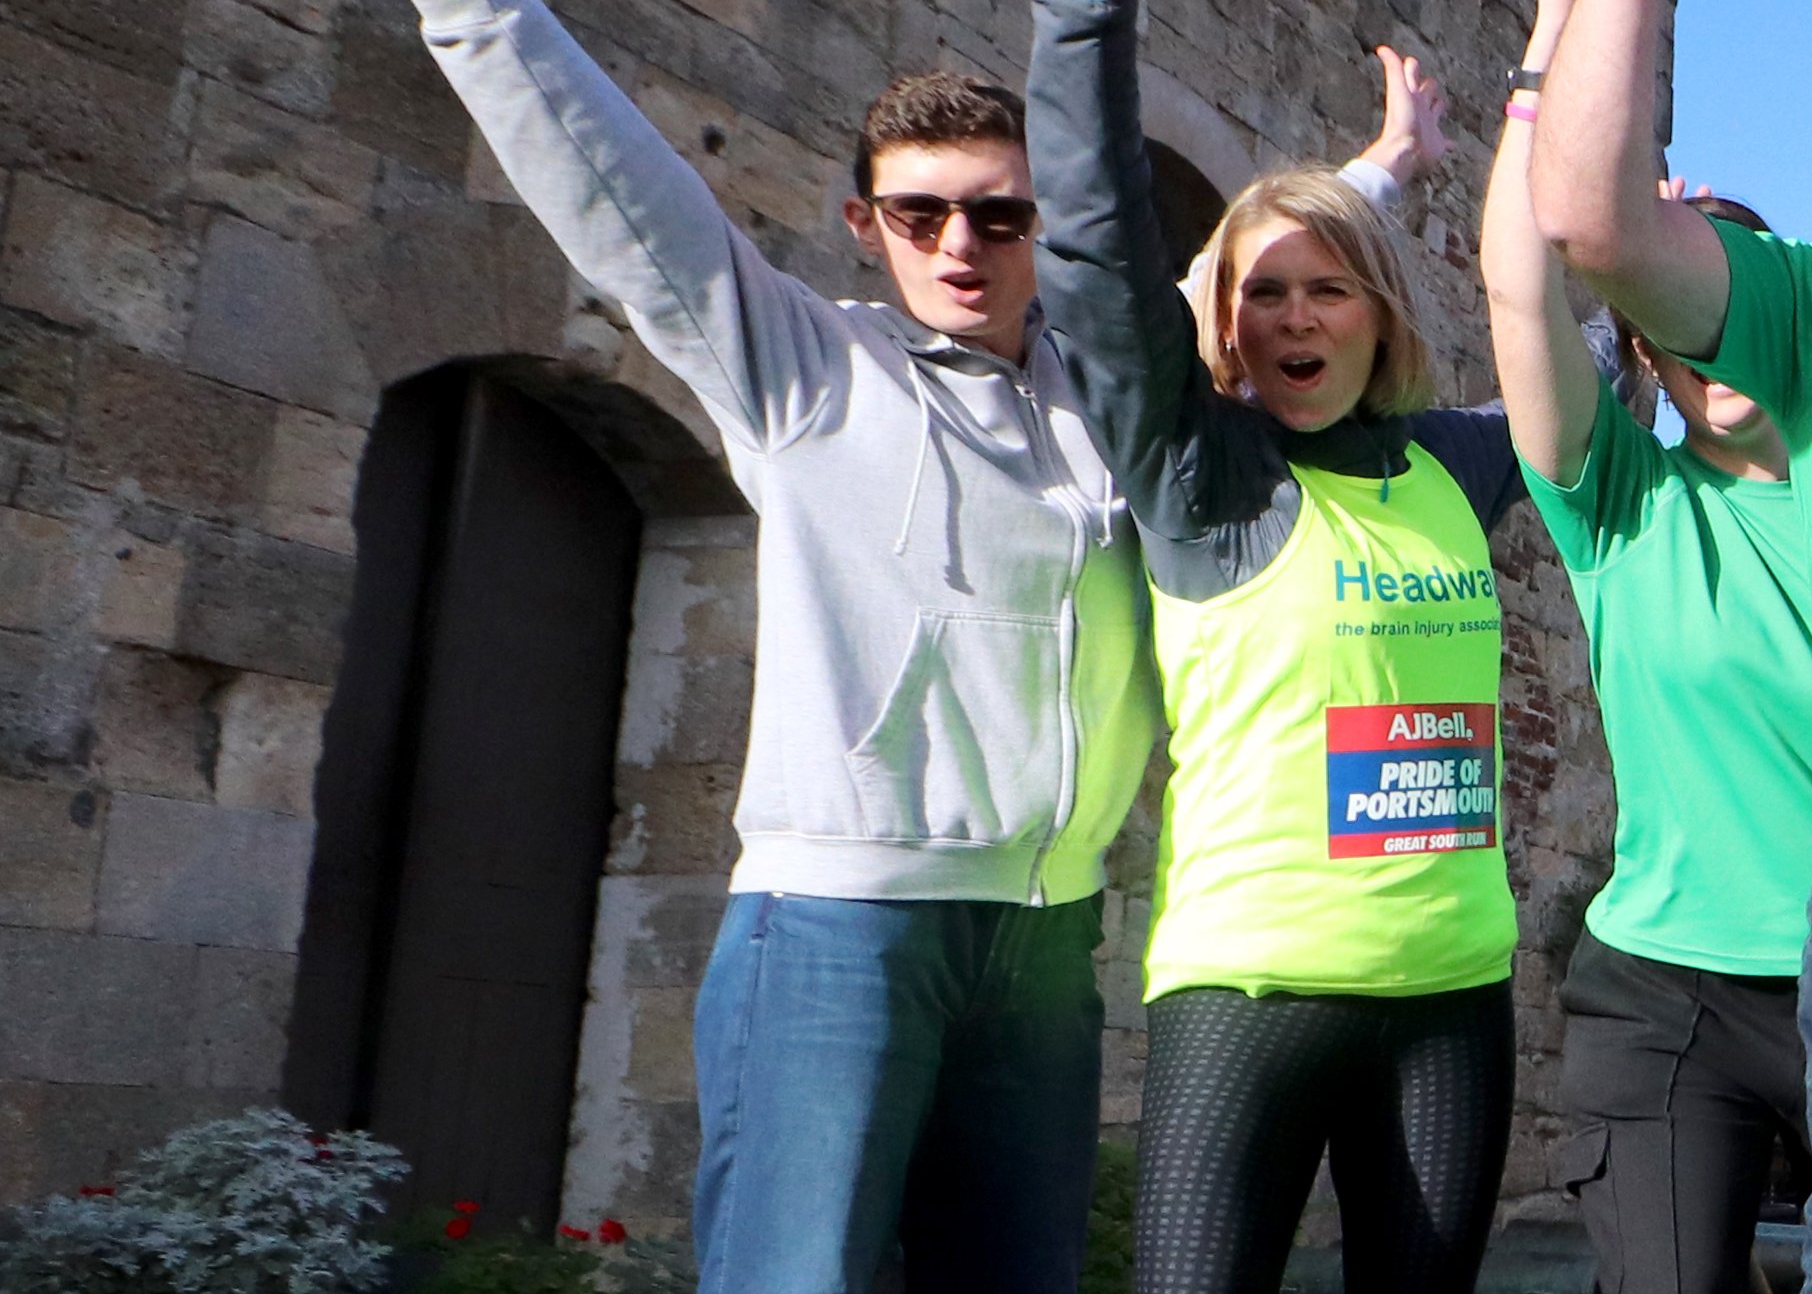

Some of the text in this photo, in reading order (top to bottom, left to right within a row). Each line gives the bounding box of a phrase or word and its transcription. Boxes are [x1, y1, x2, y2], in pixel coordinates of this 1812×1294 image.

[1335, 560, 1499, 609] Headwa
[1335, 622, 1365, 637] the
[1371, 620, 1410, 636] brain
[1414, 619, 1454, 638] injury
[1380, 759, 1482, 790] PRIDE OF
[1347, 787, 1494, 821] PORTSMOUTH
[1384, 831, 1487, 852] GREAT SOUTH RUN
